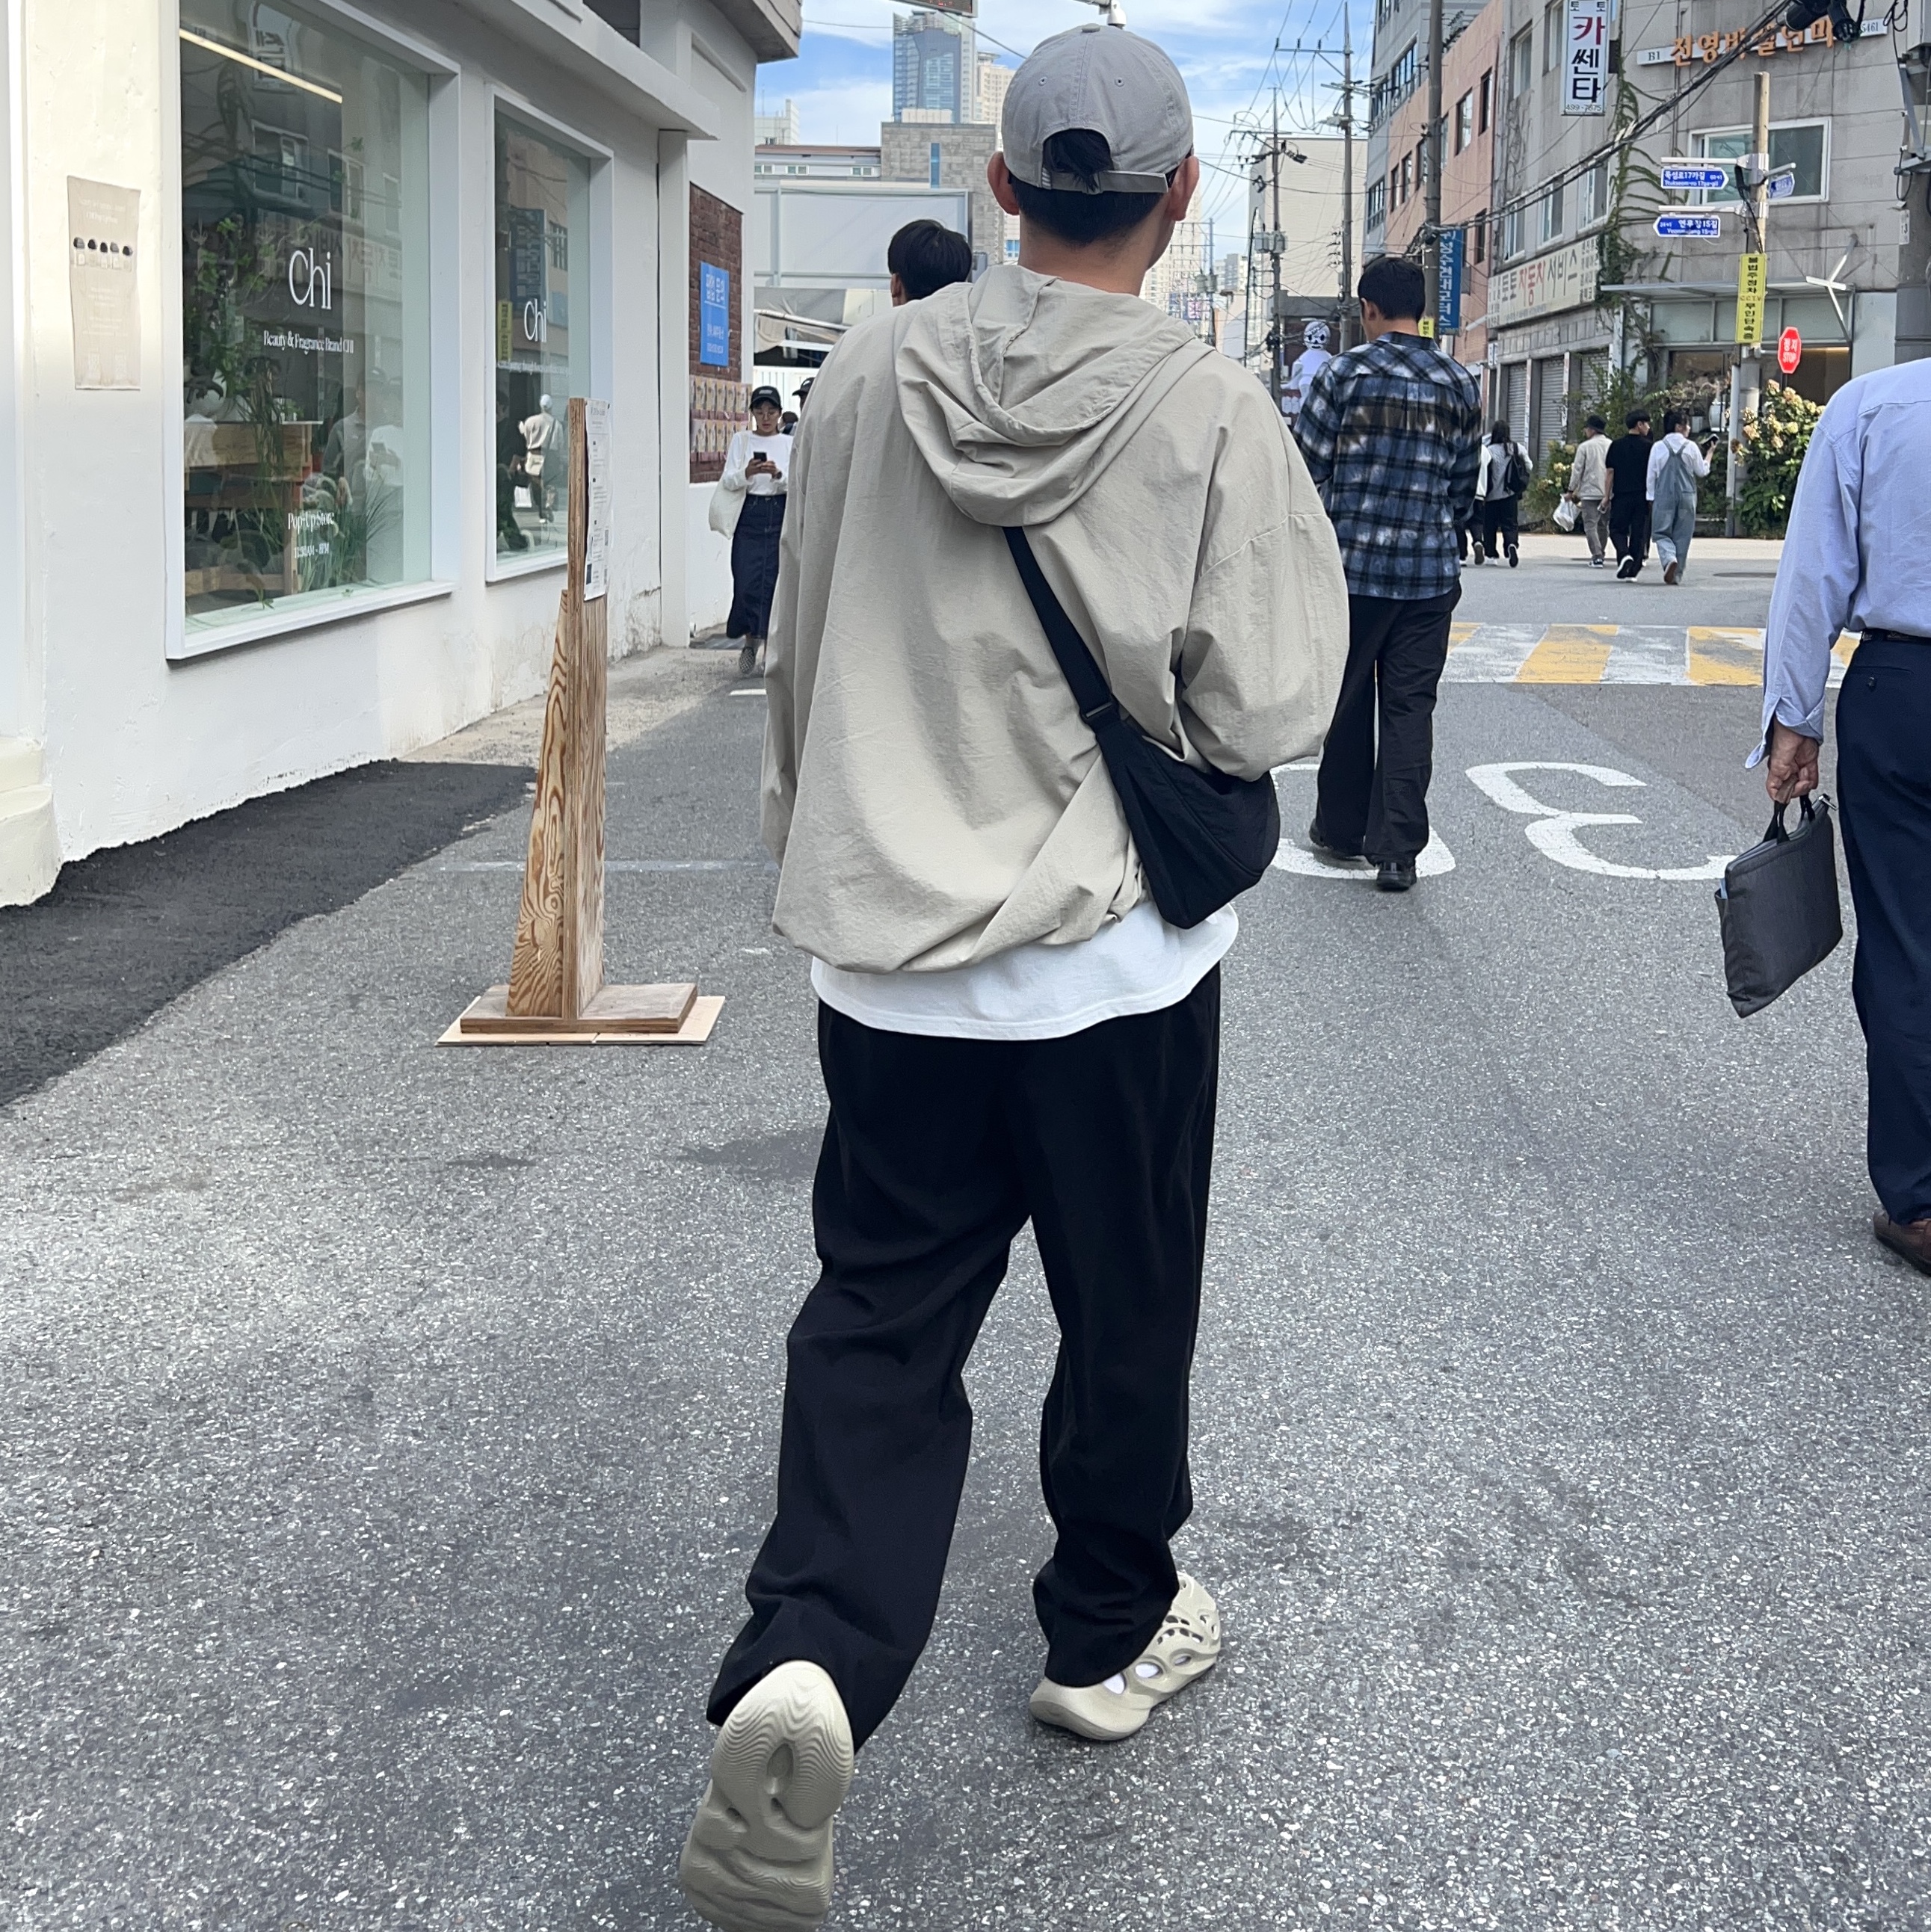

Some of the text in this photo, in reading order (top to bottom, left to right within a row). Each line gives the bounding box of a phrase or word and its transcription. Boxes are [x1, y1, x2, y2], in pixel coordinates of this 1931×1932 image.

[289, 247, 332, 310] Chi
[524, 298, 546, 342] Chi
[263, 330, 286, 351] Beauty
[287, 330, 295, 349] &
[295, 333, 324, 355] Fragrance
[325, 336, 342, 353] Brand
[1783, 338, 1798, 352] 정지
[1782, 351, 1796, 363] STOP
